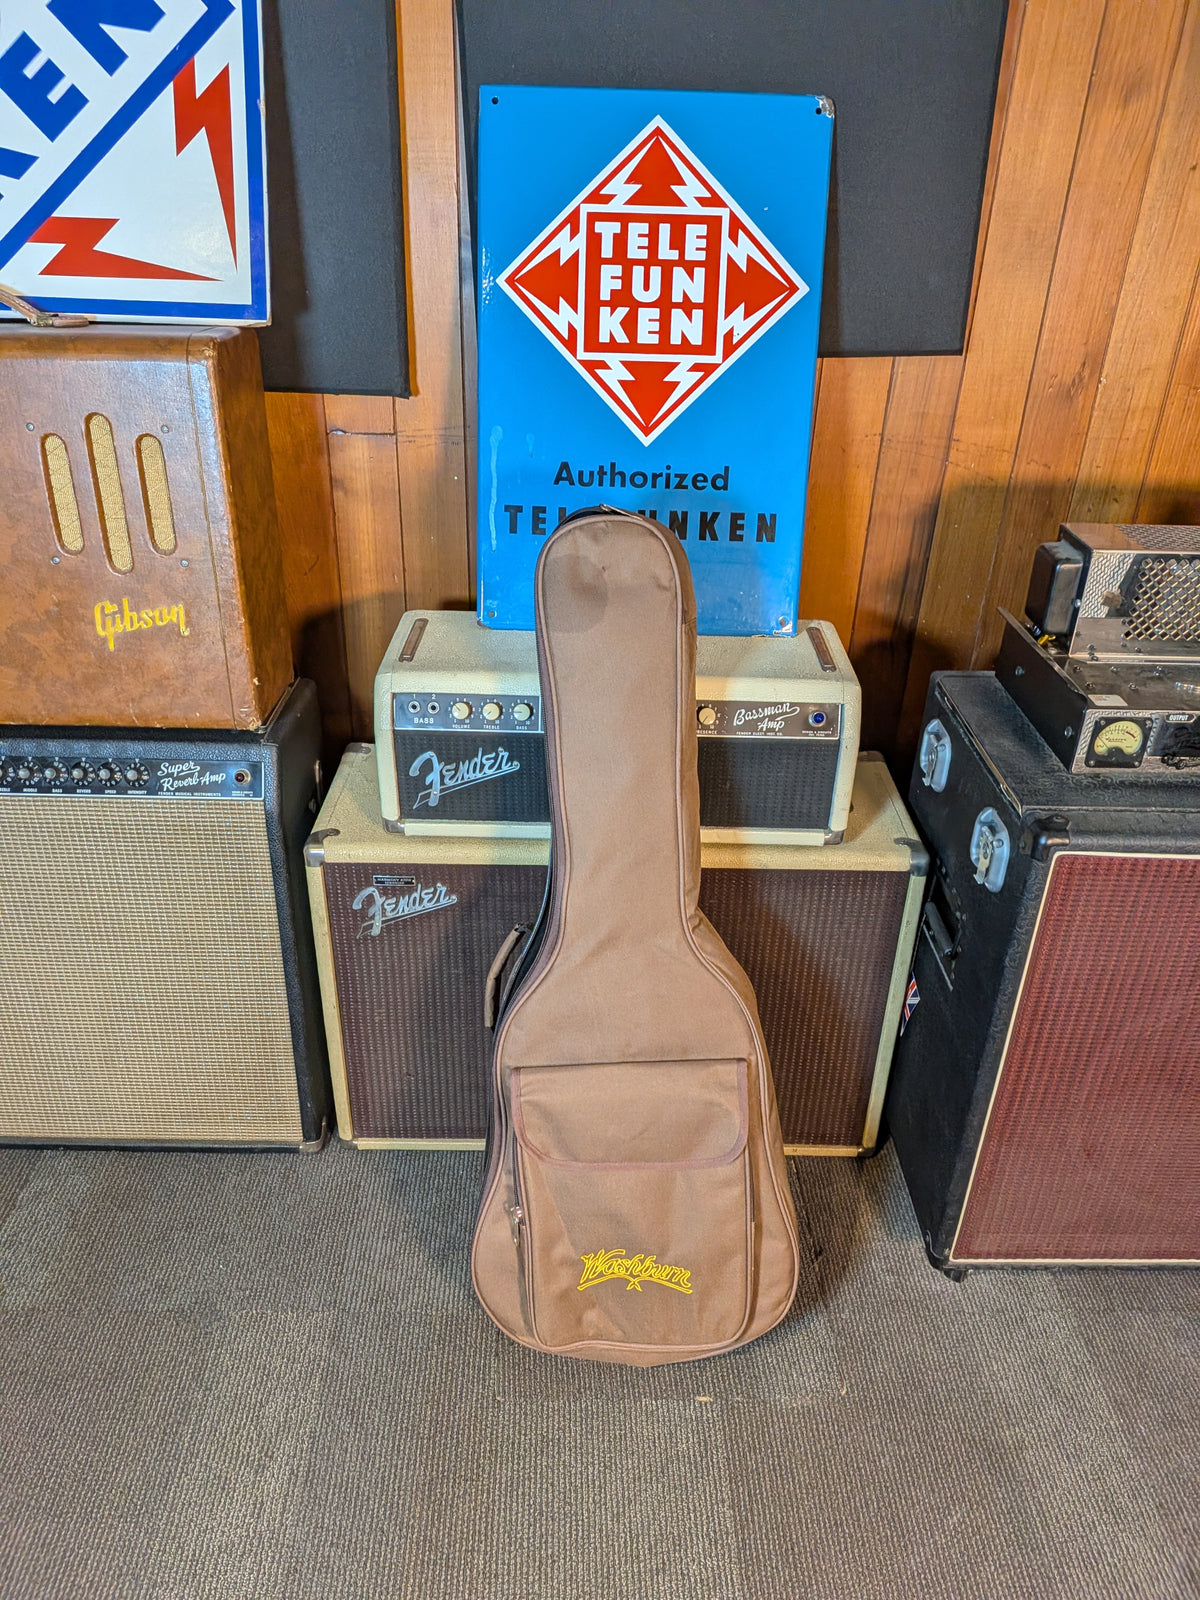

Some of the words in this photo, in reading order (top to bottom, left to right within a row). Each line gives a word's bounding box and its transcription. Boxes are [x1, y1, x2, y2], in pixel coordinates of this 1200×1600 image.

[594, 221, 708, 261] TELE
[599, 264, 706, 304] FUN
[598, 306, 703, 345] KEN
[553, 461, 730, 491] Authorized
[94, 597, 190, 651] Gibson
[733, 702, 800, 726] Bassman
[157, 761, 201, 777] Super
[409, 746, 521, 808] Fender
[352, 882, 458, 938] Fender
[577, 1249, 693, 1292] Washburn
